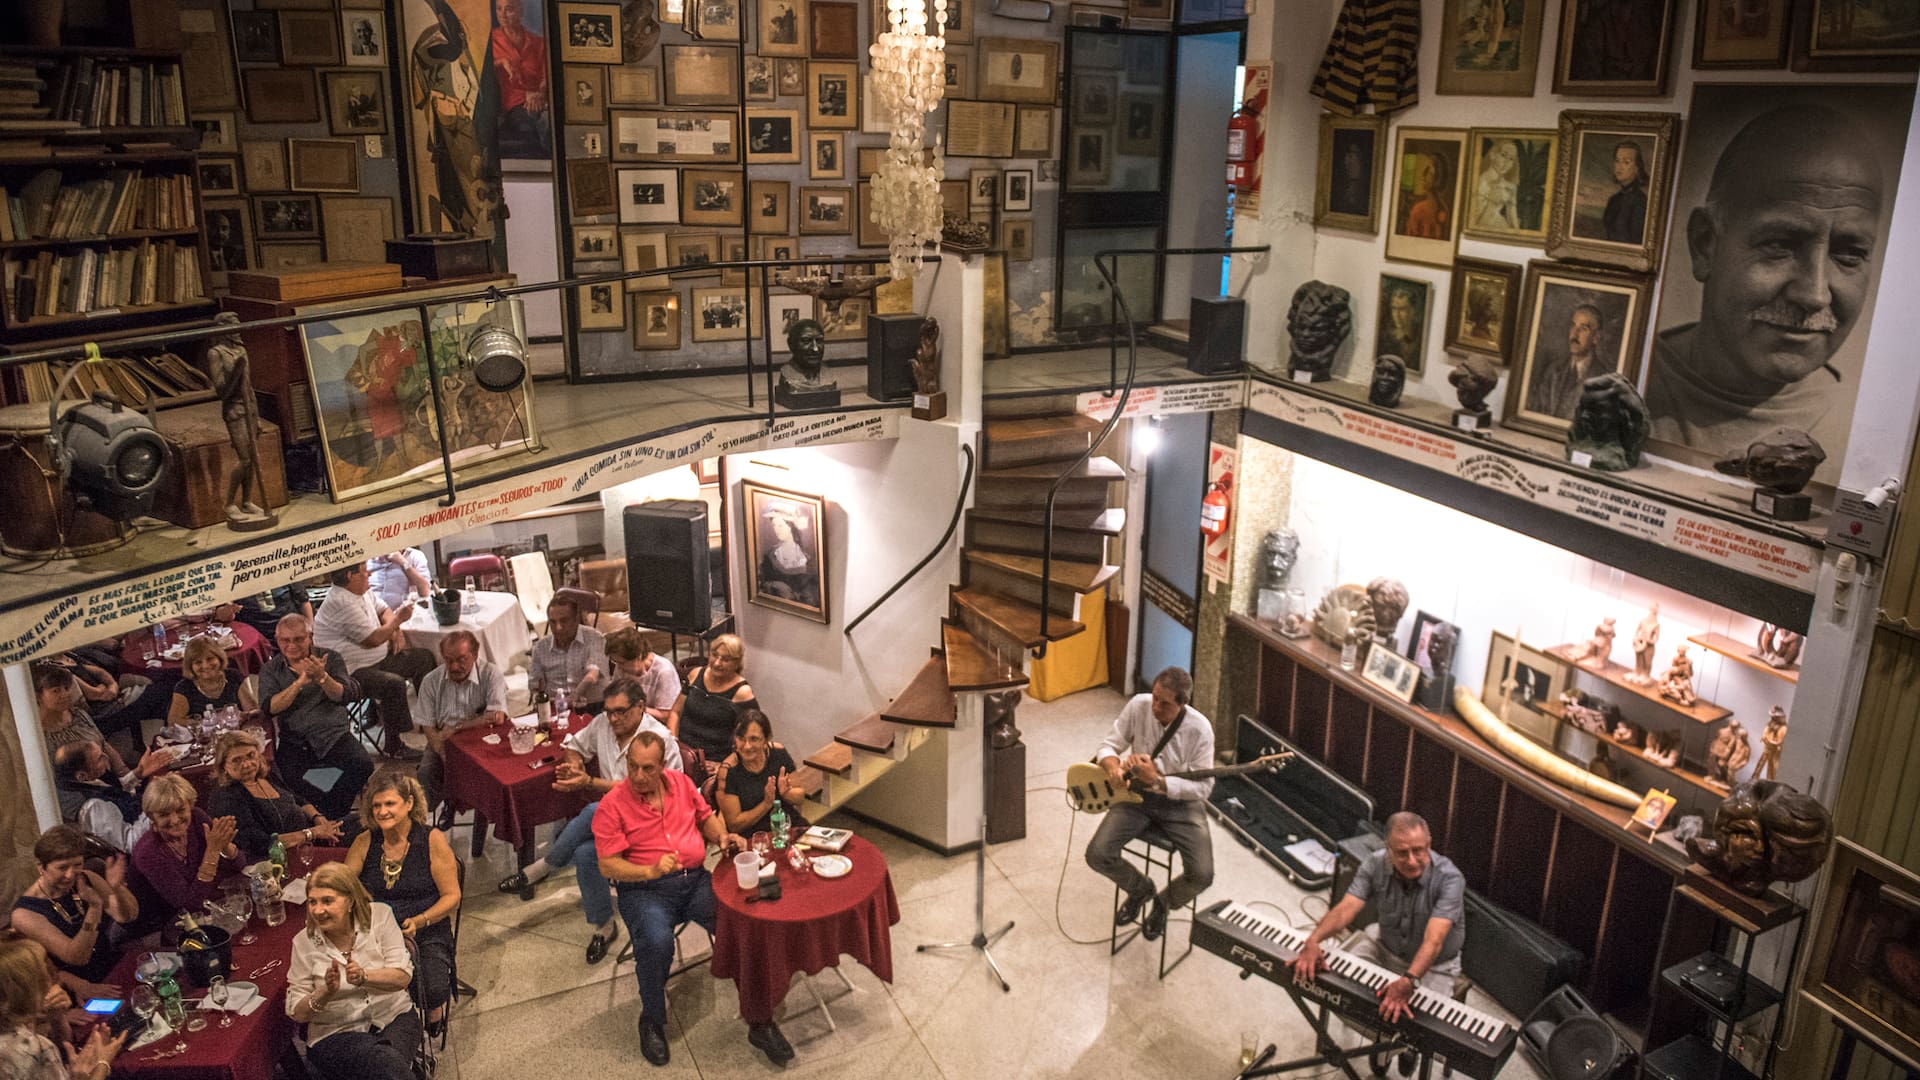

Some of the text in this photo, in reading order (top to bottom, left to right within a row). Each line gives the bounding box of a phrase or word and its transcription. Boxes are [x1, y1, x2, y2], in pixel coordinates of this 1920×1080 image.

[740, 428, 770, 445] HUBIERA
[771, 420, 794, 434] HECHO
[772, 414, 846, 442] CASO DE LA CRITICA NO
[844, 420, 864, 433] NUNCA
[864, 416, 882, 426] NADA
[589, 454, 616, 477] COMIDA
[618, 448, 632, 462] SIN
[634, 446, 654, 457] VINO
[654, 448, 665, 459] ES
[666, 450, 676, 460] UN
[677, 446, 689, 459] DIA
[690, 438, 701, 454] SIN
[403, 518, 417, 531] LOS
[418, 501, 478, 530] IGNORANTES
[478, 499, 500, 510] ESTAN
[500, 485, 534, 505] SEGUROS
[534, 486, 542, 494] DE
[290, 541, 316, 558] haga
[1675, 526, 1710, 542] TENEMOS
[1710, 536, 1728, 548] MAS
[1728, 543, 1771, 561] NECESIDAD
[1696, 521, 1747, 543] ENTUSIASMO
[1748, 538, 1759, 547] DE
[1759, 541, 1770, 550] LO
[1770, 544, 1788, 556] QUE
[88, 595, 100, 606] ES
[102, 588, 124, 600] MAS
[125, 582, 150, 596] FACIL
[153, 571, 186, 588] LLORAR
[188, 566, 204, 578] QUE
[230, 568, 262, 592] pero
[262, 564, 277, 576] no
[278, 560, 292, 572] se
[84, 582, 216, 628] DE QUE RIAMOS POR DENTRO
[88, 572, 222, 617] PERO VALE MAS REIR CON TAL
[17, 628, 36, 648] QUE
[34, 622, 47, 635] EL
[44, 596, 78, 625] CUERPO
[59, 608, 84, 630] ALMA
[1230, 944, 1274, 973] FP-4
[1292, 974, 1342, 1006] Roland
